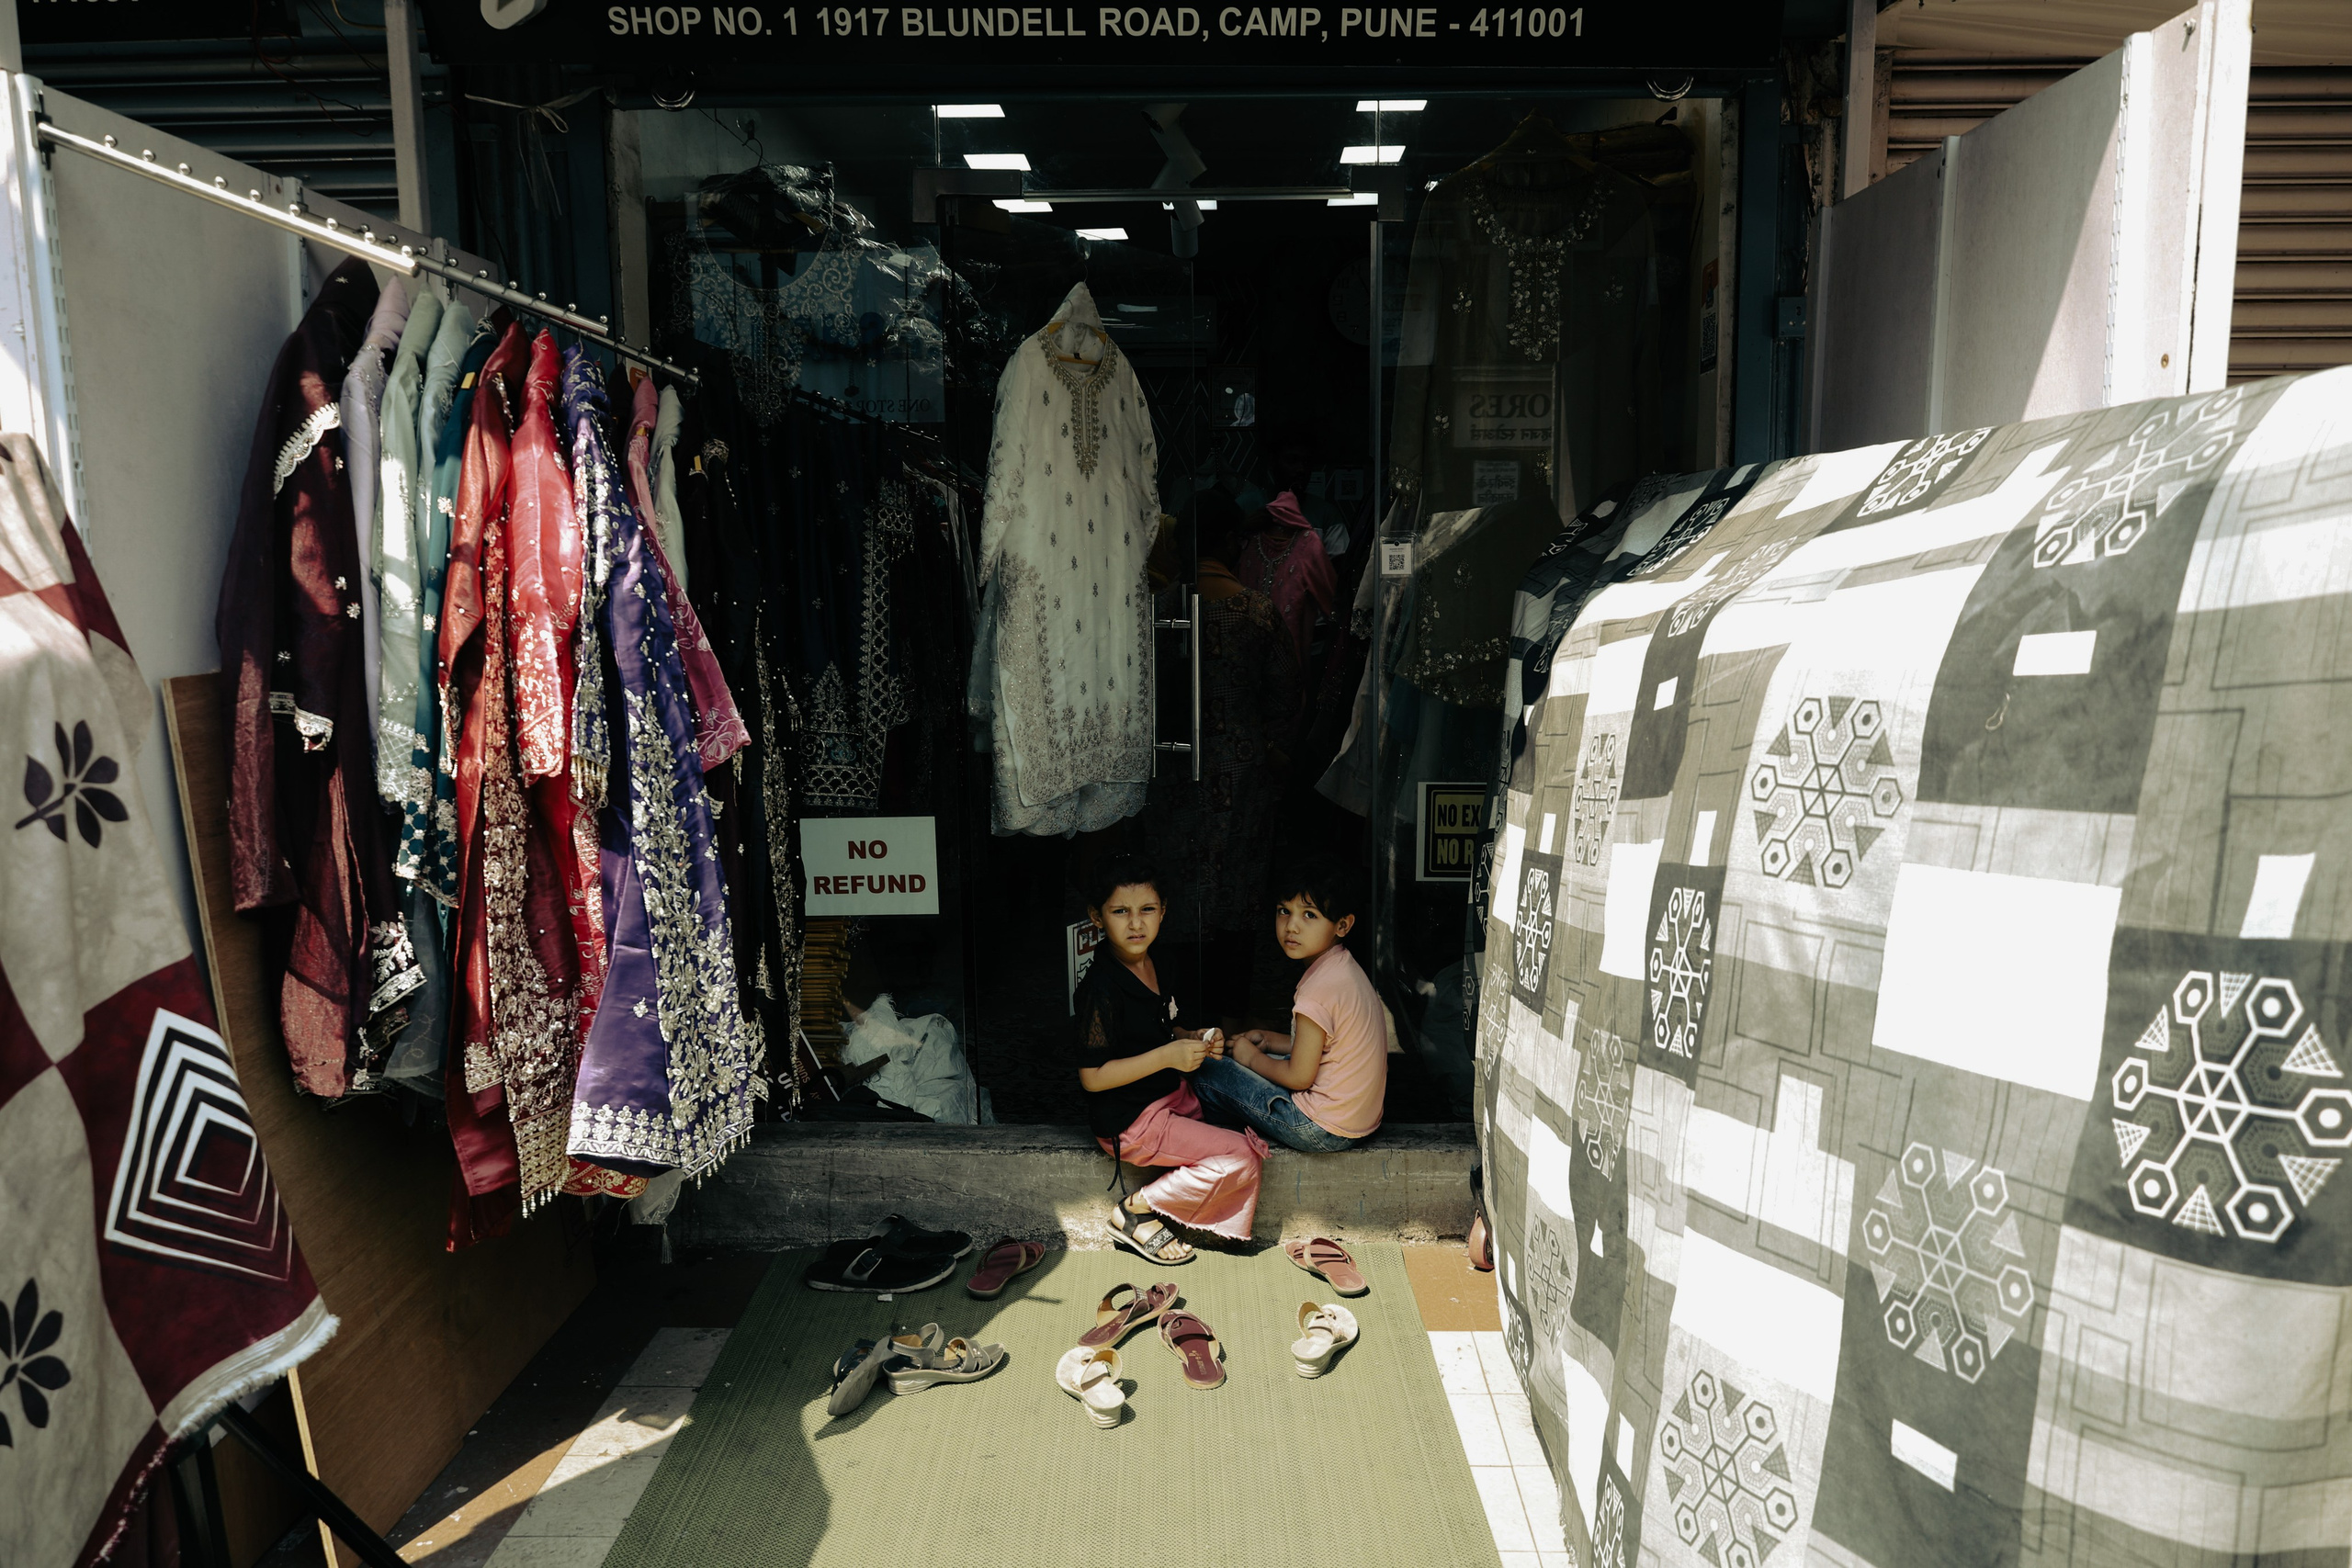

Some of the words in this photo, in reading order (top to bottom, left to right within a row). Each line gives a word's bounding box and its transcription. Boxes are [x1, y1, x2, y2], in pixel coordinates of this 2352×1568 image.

[607, 6, 702, 35] SHOP
[713, 6, 772, 36] NO.
[783, 6, 797, 36] 1
[816, 7, 889, 37] 1917
[901, 7, 1087, 37] BLUNDELL
[1099, 6, 1209, 42] ROAD,
[1218, 6, 1328, 43] CAMP,
[1340, 7, 1437, 38] PUNE
[1469, 7, 1583, 38] 411001
[1437, 804, 1458, 828] NO
[1462, 804, 1484, 828] EX
[848, 840, 888, 860] NO
[1436, 838, 1459, 865] NO
[813, 874, 926, 895] REFUND
